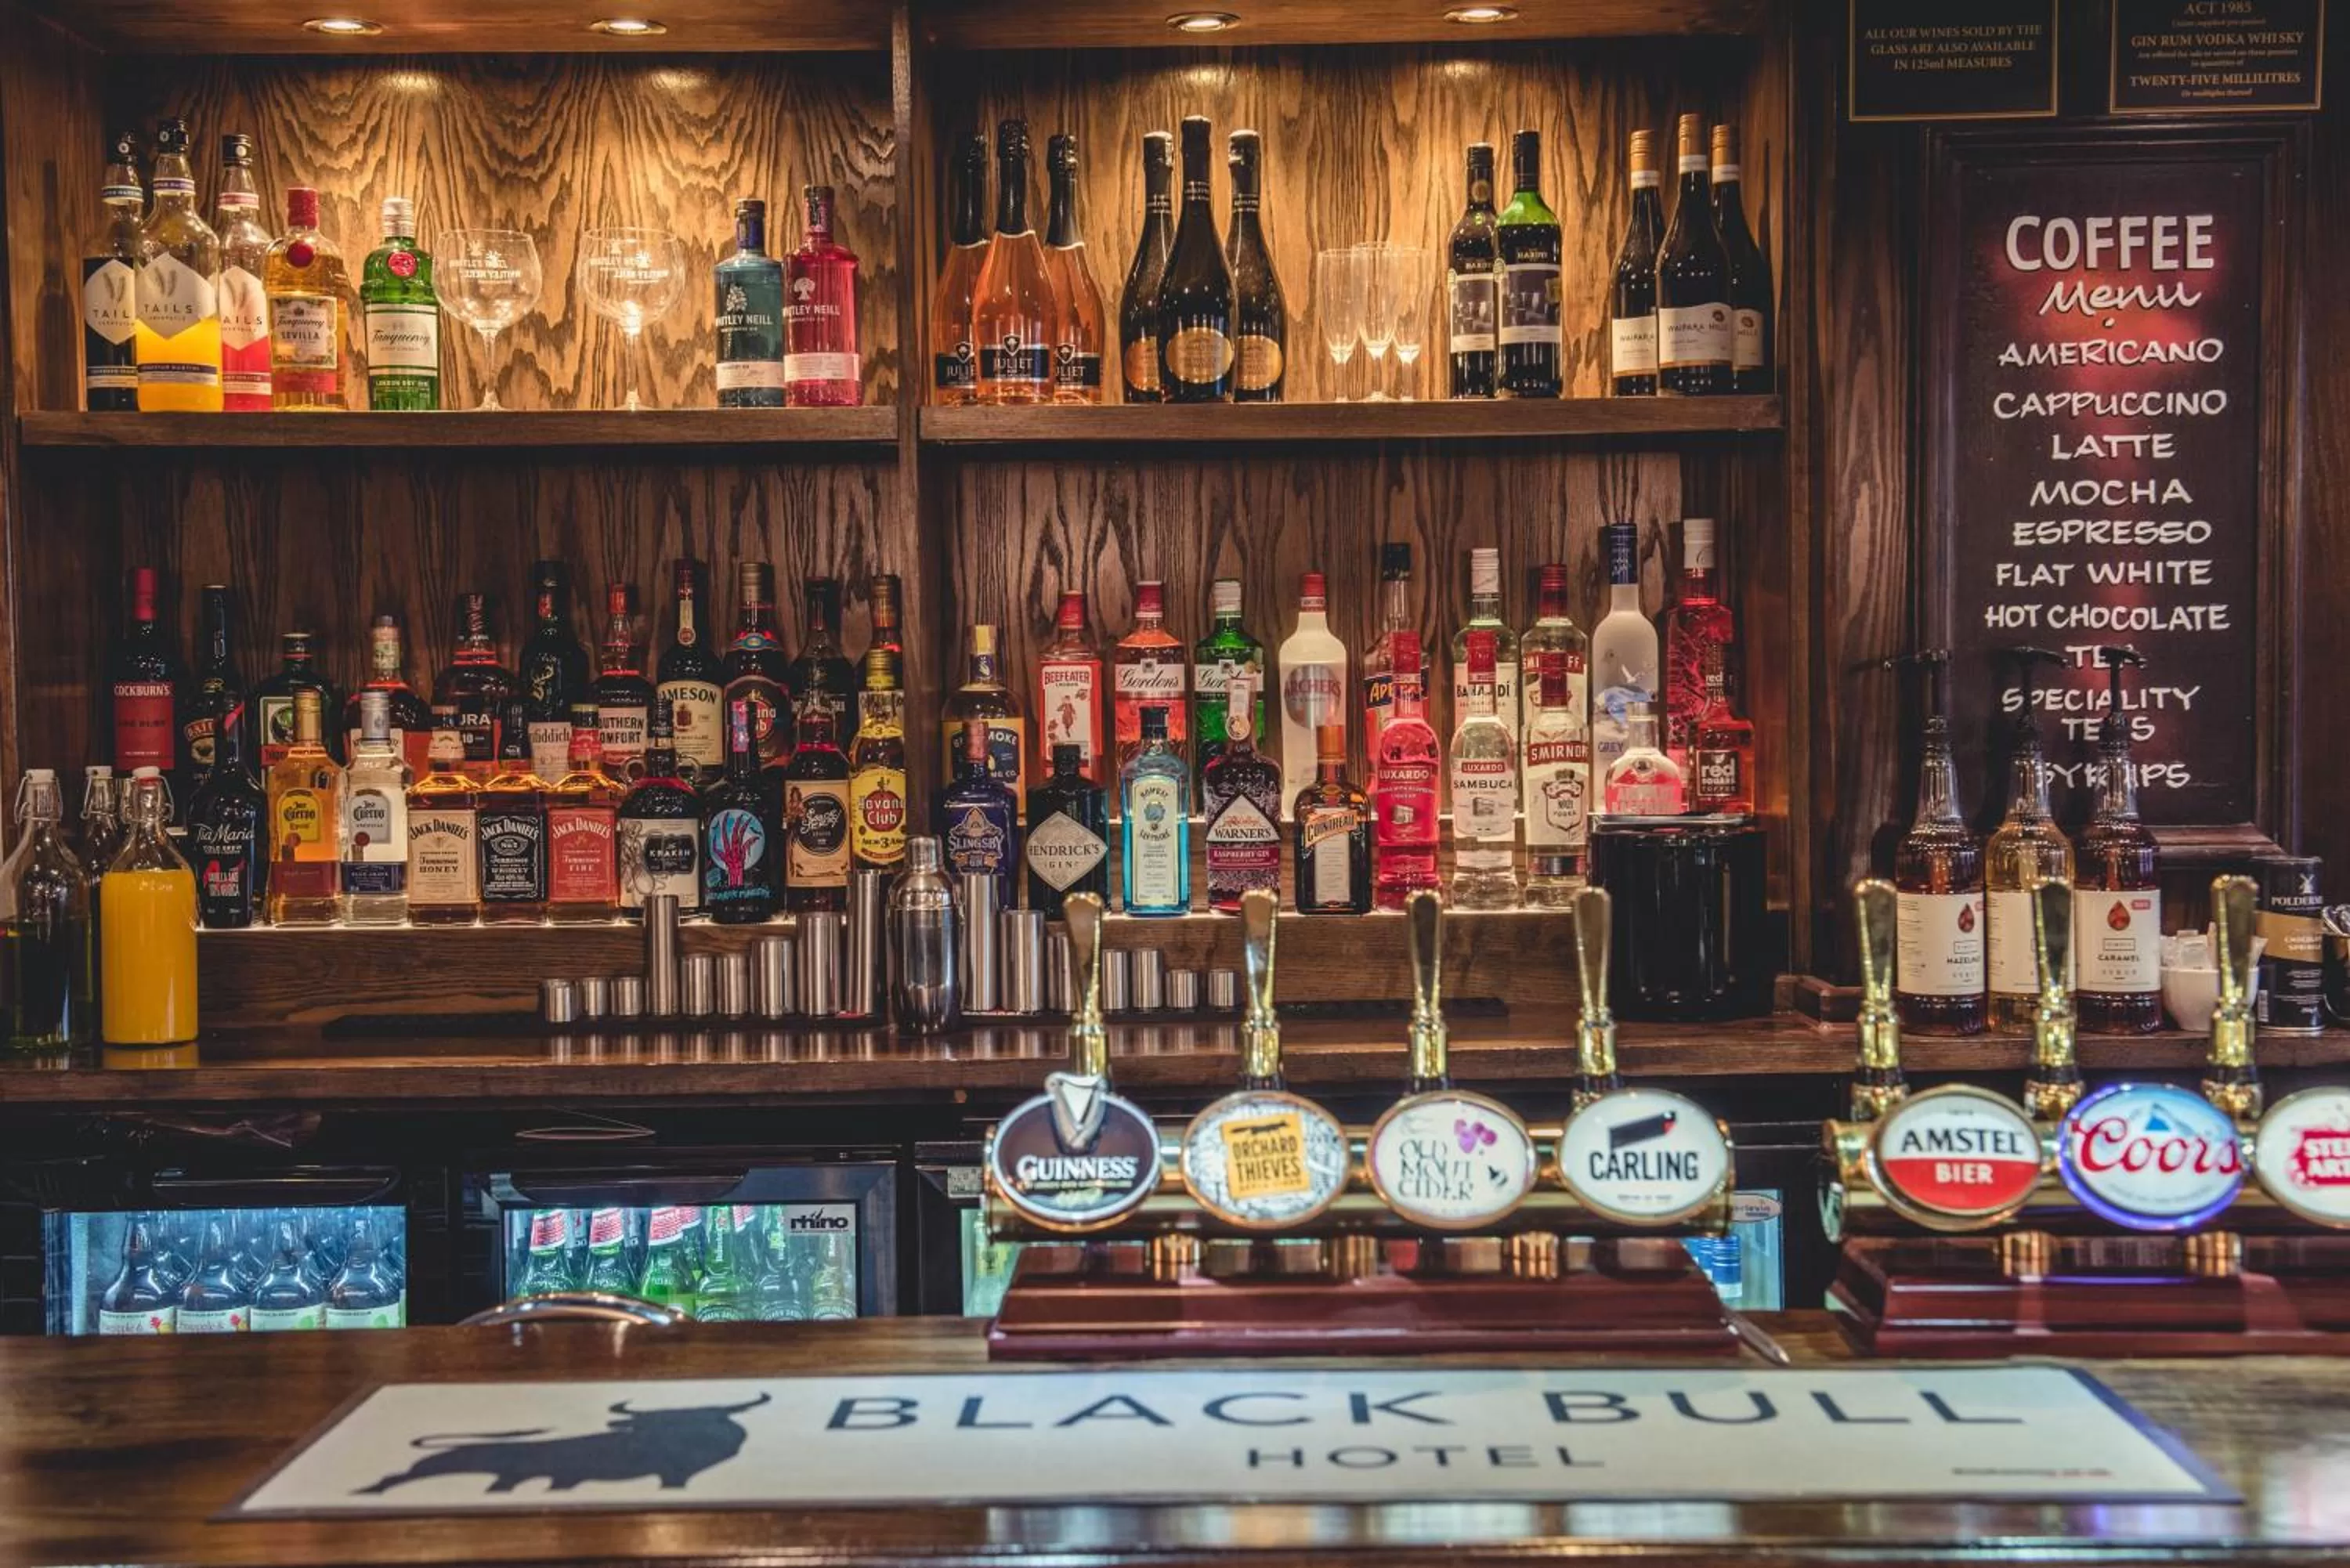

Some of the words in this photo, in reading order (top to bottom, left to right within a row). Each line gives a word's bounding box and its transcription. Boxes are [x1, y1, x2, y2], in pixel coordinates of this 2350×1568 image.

[2184, 2, 2214, 14] ACT
[1865, 28, 1887, 39] ALL
[1889, 27, 1916, 39] OUR
[1918, 27, 1958, 38] WINES
[1959, 27, 1995, 38] SOLD
[1998, 25, 2014, 37] BY
[2016, 24, 2042, 36] THE
[2131, 34, 2157, 48] GIN
[2160, 34, 2192, 47] RUM
[2195, 32, 2246, 45] VODKA
[2247, 31, 2305, 45] WHISKY
[1870, 44, 1908, 55] GLASS
[1911, 43, 1936, 54] ARE
[1937, 42, 1969, 53] ALSO
[1970, 40, 2036, 52] AVAILABLE
[1894, 59, 1908, 70] IN
[1946, 56, 2012, 69] MEASURES
[2129, 74, 2220, 88] TWENTY-FIVE
[2222, 71, 2301, 85] MILLILITRES
[2005, 215, 2214, 272] COFFEE
[2038, 280, 2202, 316] Menu
[92, 309, 130, 320] TAIL
[144, 304, 193, 314] TAILS
[814, 304, 840, 316] NEILL
[223, 316, 263, 326] AILS
[277, 316, 325, 328] Tanqueray
[746, 315, 772, 326] NEILL
[280, 331, 320, 340] SEVILLA
[371, 329, 430, 346] Tanqueray
[1998, 338, 2225, 367] AMERICANO
[1993, 390, 2228, 419] CAPPUCCINO
[2052, 432, 2178, 461] LATTE
[2030, 478, 2193, 508] MOCHA
[2012, 519, 2213, 547] ESPRESSO
[1995, 562, 2076, 587] FLAT
[2087, 559, 2214, 586] WHITE
[1984, 604, 2043, 628] HOT
[2046, 603, 2232, 632] CHOCOLATE
[1523, 656, 1581, 670] SMIFF
[1043, 670, 1090, 684] BEEFEATER
[1118, 666, 1179, 690] Gordon's
[114, 685, 171, 697] COCKBURN'S
[661, 688, 717, 704] AMESON
[1285, 679, 1342, 697] ARCHERS
[599, 732, 642, 744] OMFORT
[2061, 716, 2157, 742] TES
[1597, 741, 1624, 753] GREY
[1379, 769, 1430, 780] LUXARDO
[1462, 764, 1504, 772] LUXARDO
[1701, 757, 1736, 778] red
[1140, 787, 1169, 799] BOMBAY
[1453, 779, 1513, 789] SAMBUCA
[283, 807, 316, 821] Cuervo
[353, 805, 385, 822] Cuervo
[867, 811, 897, 825] Club
[193, 822, 213, 844] Tia
[211, 822, 255, 844] Maria
[410, 822, 432, 840] JACK
[433, 819, 470, 840] DANIEL'S
[480, 822, 504, 840] JACK
[504, 819, 540, 840] DANIEL'S
[552, 821, 576, 840] JACK
[576, 816, 612, 840] DANIEL'S
[880, 837, 889, 848] 3
[948, 834, 1003, 852] SLINGSBY
[1028, 844, 1100, 857] HENDRICK'S
[2096, 954, 2141, 963] CARAMEL
[1232, 1135, 1299, 1160] ORCHARD
[1399, 1140, 1448, 1159] OLD
[1901, 1128, 2026, 1156] AMSTEL
[2071, 1118, 2243, 1174] Coors
[1016, 1154, 1139, 1181] GUINNESS
[1235, 1156, 1301, 1183] THIEVES
[1401, 1158, 1471, 1180] MOUT
[1589, 1151, 1699, 1181] CARLING
[1934, 1162, 1994, 1185] BIER
[1398, 1180, 1474, 1201] CIDER
[790, 1212, 848, 1230] rhino
[823, 1390, 1461, 1432] BLACK
[1542, 1390, 2026, 1425] BULL
[1247, 1444, 1607, 1469] HOTEL
